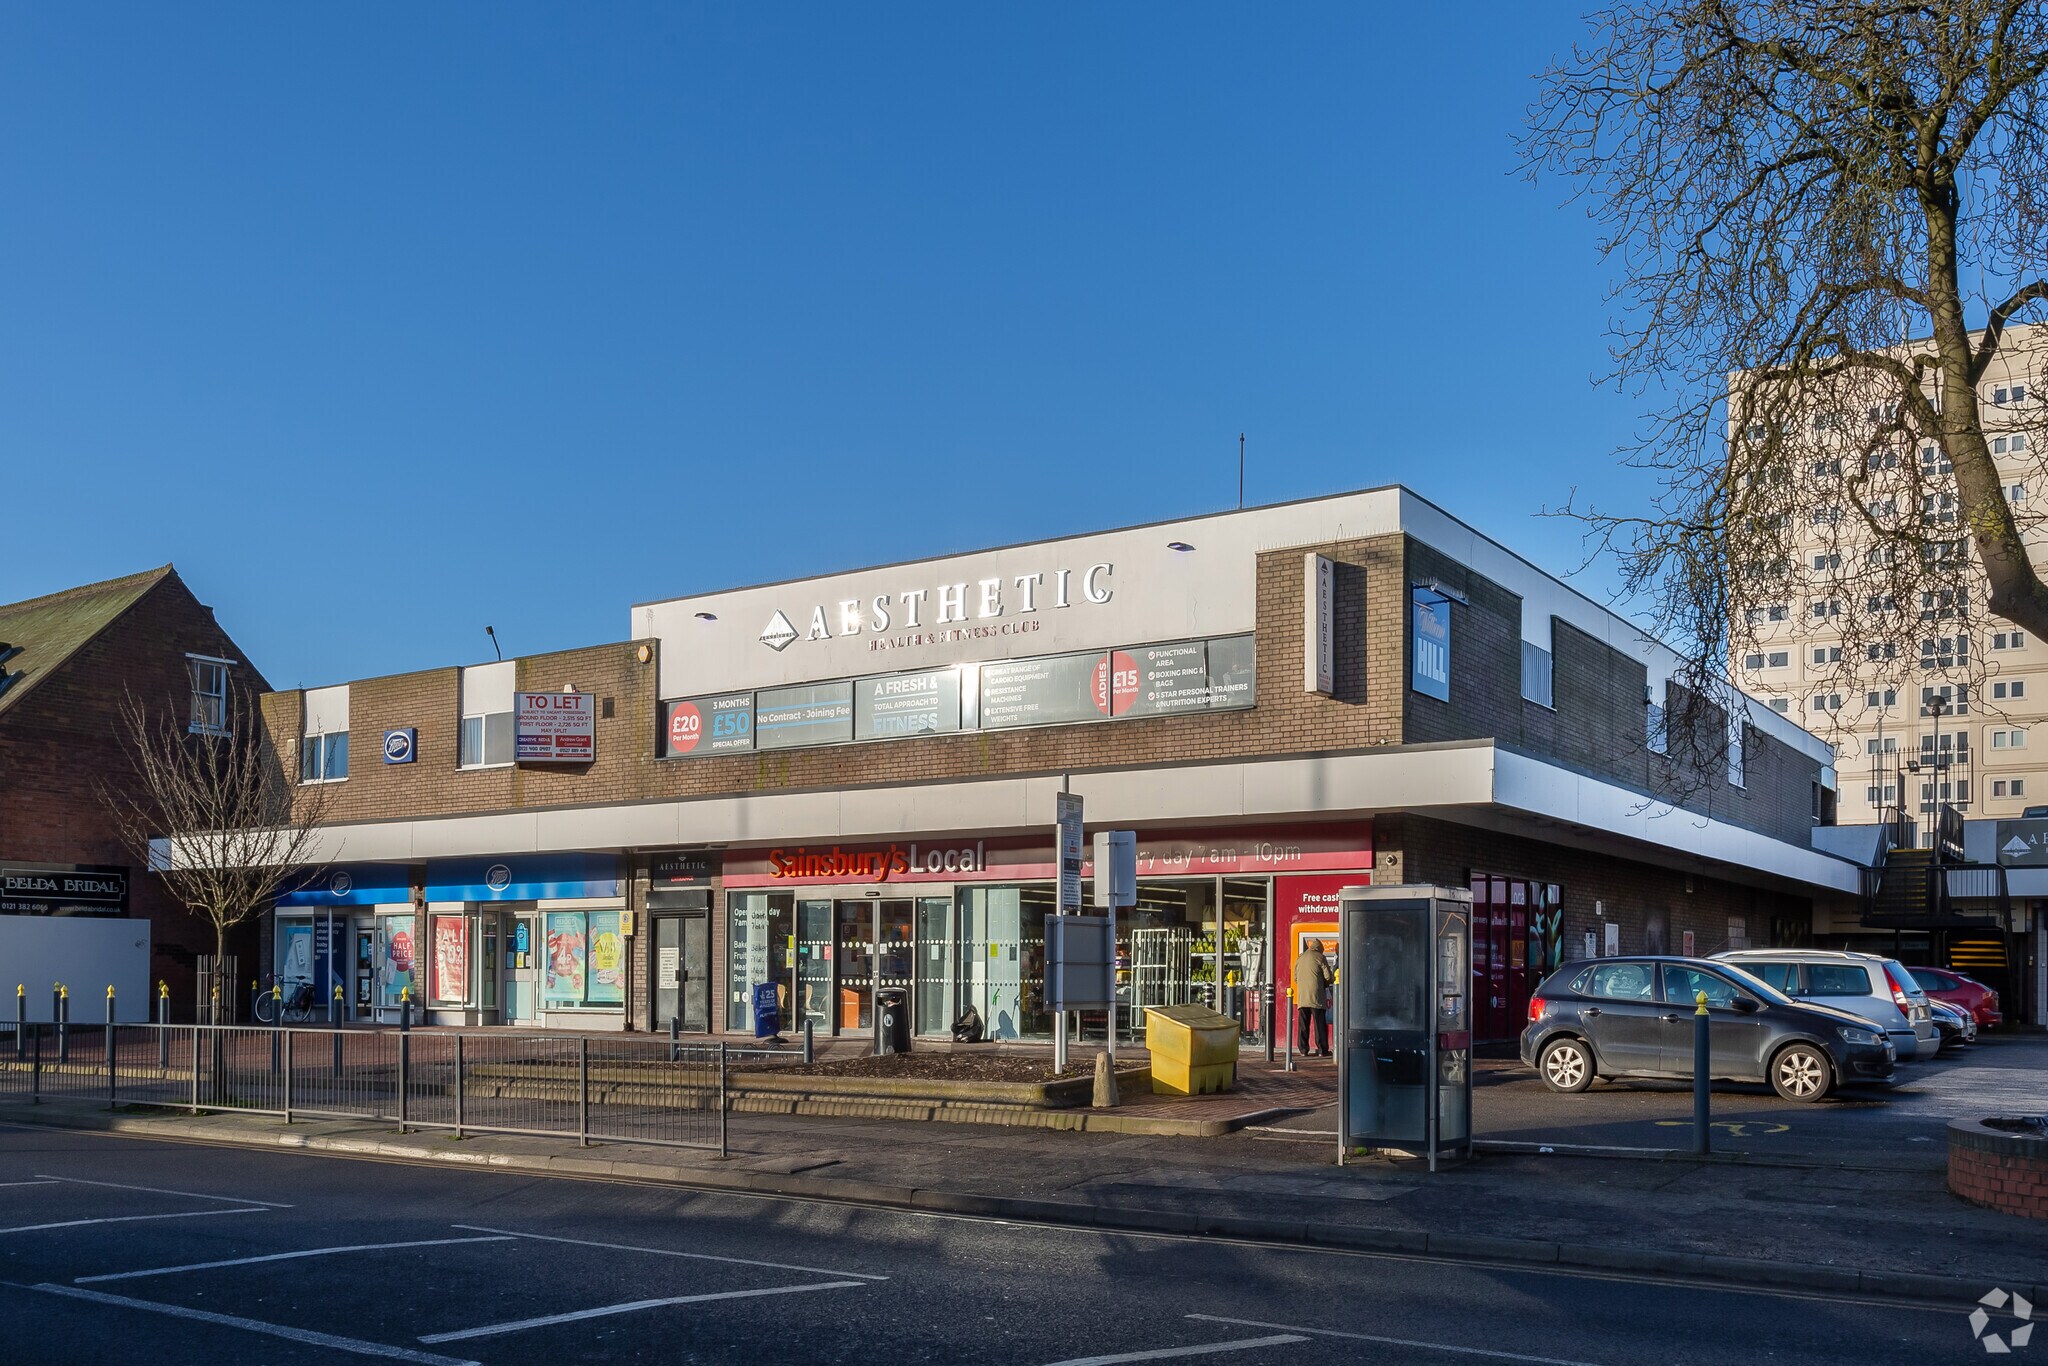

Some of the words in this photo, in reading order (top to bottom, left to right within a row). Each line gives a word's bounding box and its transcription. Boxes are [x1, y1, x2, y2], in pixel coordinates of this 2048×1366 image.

[805, 562, 1113, 640] AESTHETIC
[869, 634, 922, 650] HEALTH
[925, 633, 935, 644] &
[939, 625, 997, 642] FITNESS
[1002, 620, 1040, 635] CLUB
[1156, 648, 1197, 658] FUNCTIONAL
[1417, 637, 1445, 684] HILL
[991, 668, 1010, 676] GREAT
[1015, 672, 1049, 682] EQUIPMENT
[1156, 670, 1181, 678] BOXING
[1182, 668, 1198, 676] RING
[1113, 670, 1138, 687] £15
[874, 683, 884, 695] A
[886, 678, 926, 694] FRESH
[929, 676, 938, 689] &
[991, 686, 1026, 695] RESISTANCE
[1178, 687, 1213, 696] PERSONAL
[1214, 684, 1248, 692] TRAINERS
[526, 696, 548, 709] TO
[554, 696, 581, 709] LET
[719, 698, 750, 709] MONTHS
[894, 698, 928, 708] APPROACH
[991, 695, 1022, 703] MACHINES
[1197, 695, 1227, 704] EXPERTS
[769, 712, 801, 722] Contract
[807, 708, 834, 718] Joining
[836, 707, 850, 715] Fee
[991, 705, 1022, 714] EXTENSIVE
[673, 715, 699, 732] £20
[713, 712, 749, 736] £50
[873, 712, 938, 734] FITNESS
[769, 844, 908, 880] Sainsbury's
[911, 841, 983, 873] Local
[1163, 846, 1192, 868] day
[1198, 845, 1236, 864] 7am
[1255, 842, 1301, 864] 10pm
[660, 862, 706, 870] AESTHETIC
[5, 877, 58, 890] BELDA
[64, 880, 119, 893] BRIDAL
[1303, 894, 1320, 902] Free
[1511, 892, 1524, 905] oca
[60, 905, 120, 913] www.beldabridal.co.uk
[769, 908, 780, 917] day
[1299, 905, 1339, 913] withdrawa
[766, 990, 775, 998] 25
